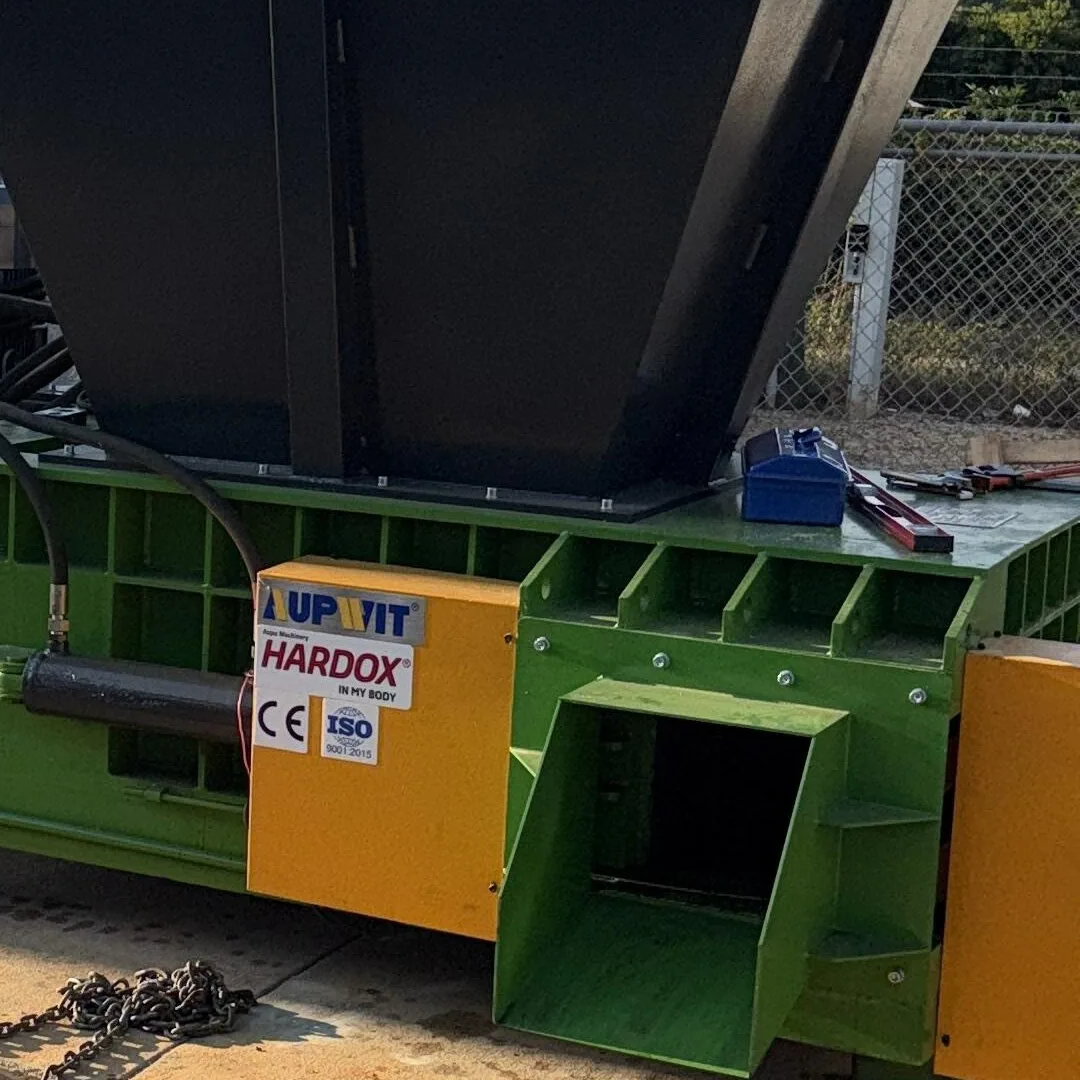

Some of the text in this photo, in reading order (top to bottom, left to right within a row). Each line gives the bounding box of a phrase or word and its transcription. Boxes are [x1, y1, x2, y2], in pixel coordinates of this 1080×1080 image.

[338, 685, 397, 702] IN MY BODY
[258, 700, 306, 742] CE
[327, 715, 373, 739] ISO
